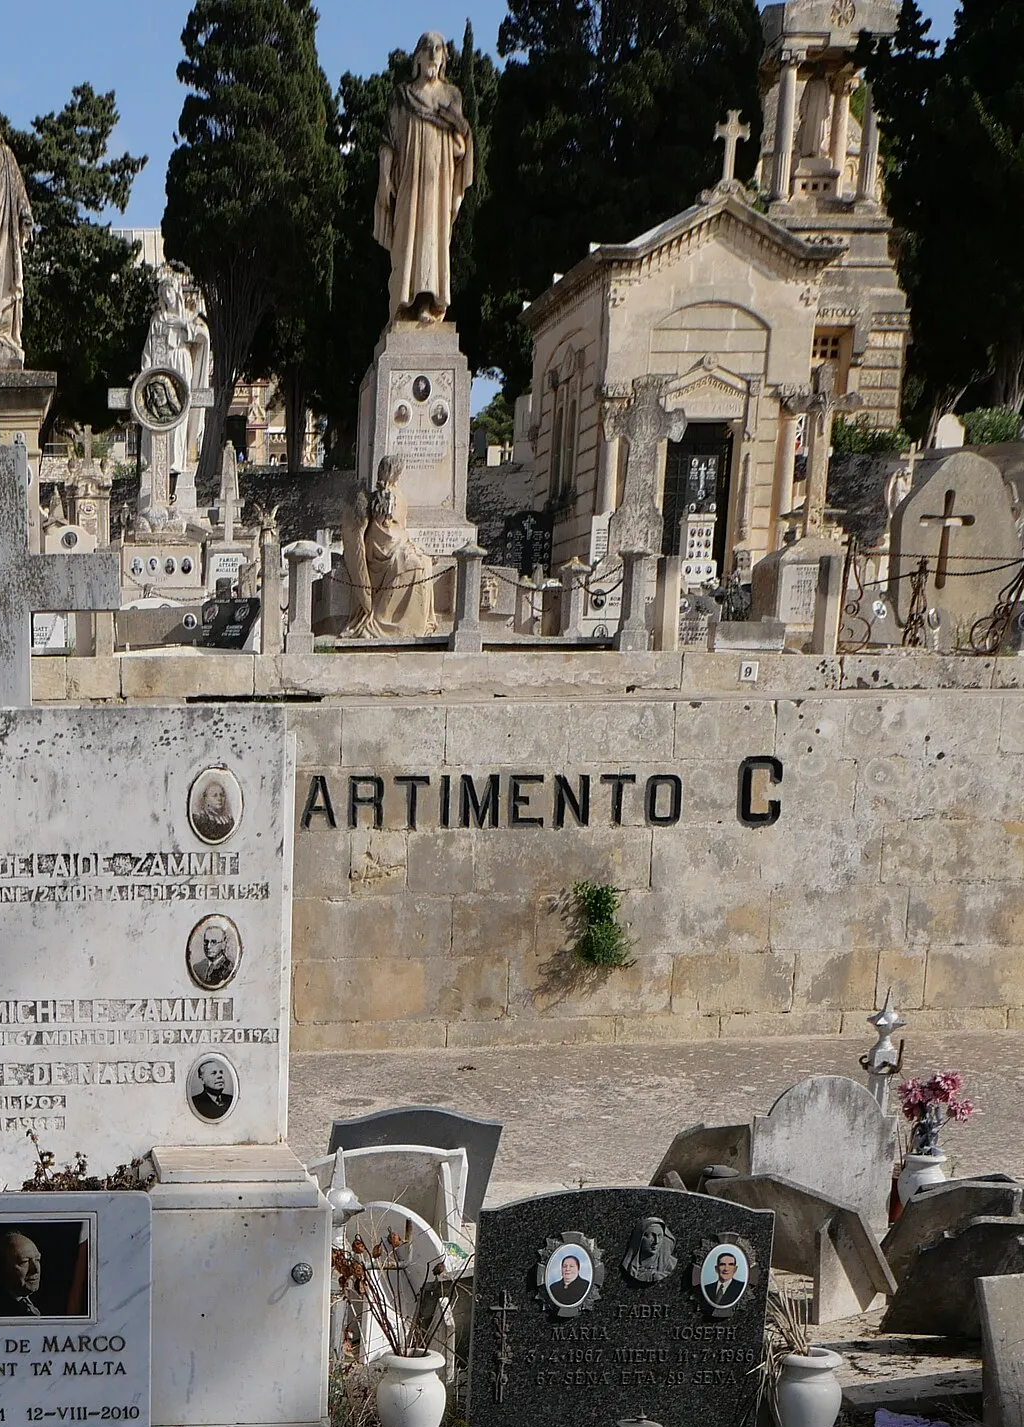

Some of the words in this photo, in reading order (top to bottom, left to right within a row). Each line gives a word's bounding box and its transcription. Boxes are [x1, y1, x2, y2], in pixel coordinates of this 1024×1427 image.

[743, 666, 752, 677] 9
[300, 774, 682, 829] ARTIMENTO
[737, 755, 783, 828] C
[131, 851, 241, 877] ZAMMIT
[54, 884, 122, 902] MORTA
[171, 884, 190, 900] 29
[196, 884, 228, 900] GEN
[125, 998, 232, 1022] ZAMMIT
[16, 1030, 37, 1046] 67
[42, 1030, 108, 1046] MORTO
[180, 1028, 245, 1044] MARZO
[34, 1063, 66, 1086] DE
[77, 1061, 173, 1084] MARCO
[617, 1304, 670, 1319] FABRI
[550, 1327, 610, 1342] MARIA
[672, 1326, 737, 1341] JOSEPH
[5, 1338, 31, 1354] DE
[42, 1335, 126, 1353] MARCO
[30, 1360, 53, 1377] TA'
[63, 1360, 127, 1377] MALTA
[563, 1370, 610, 1385] SENA
[620, 1370, 657, 1385] ETA
[691, 1370, 737, 1385] SENA
[26, 1405, 140, 1422] 12-VIII-2010
